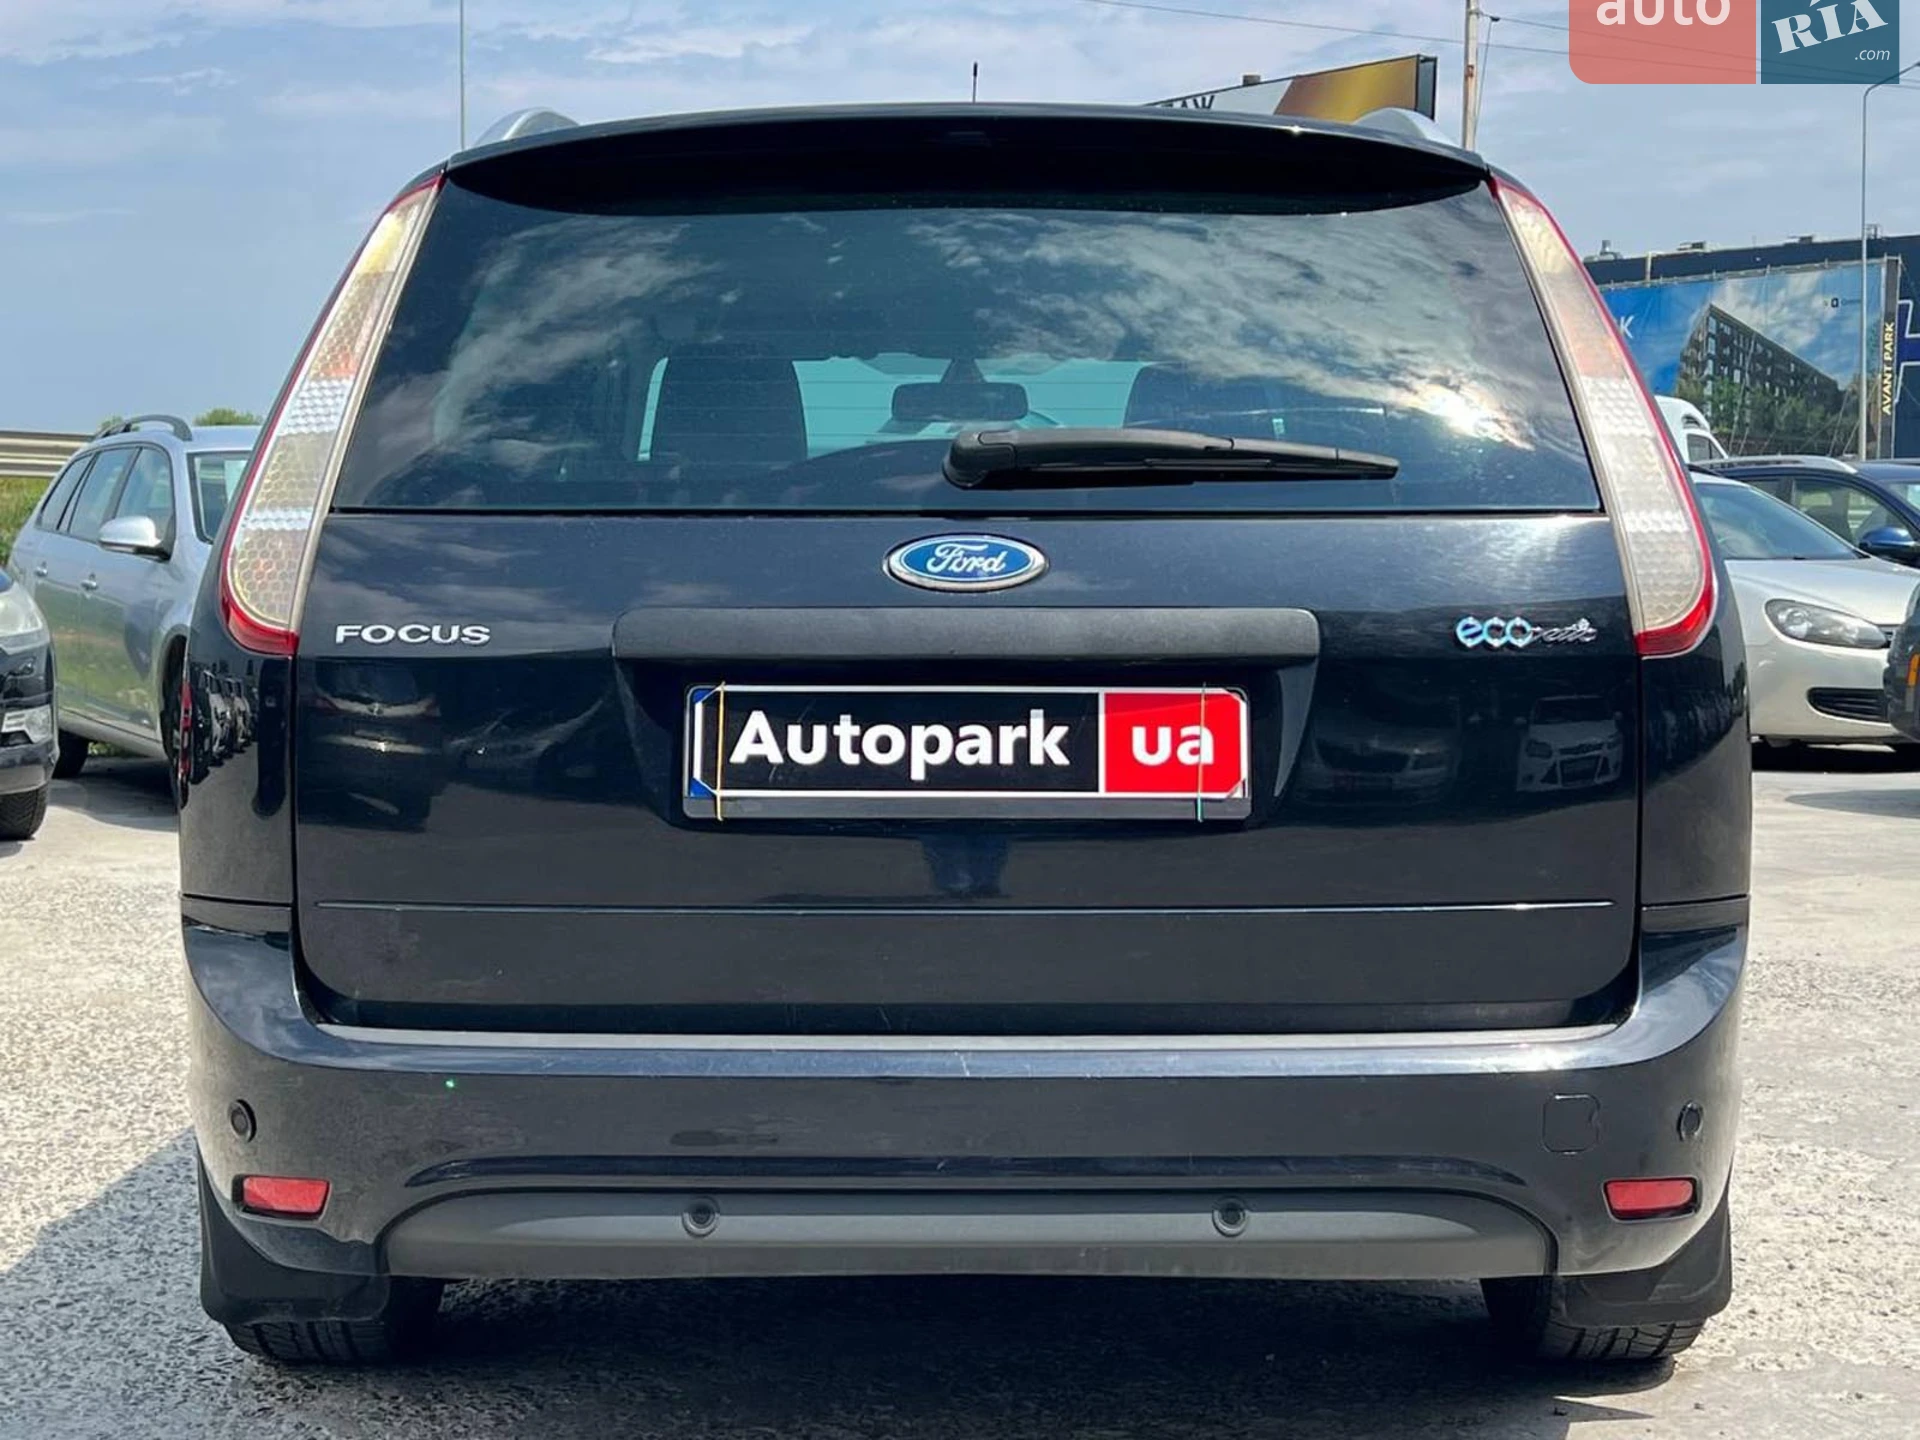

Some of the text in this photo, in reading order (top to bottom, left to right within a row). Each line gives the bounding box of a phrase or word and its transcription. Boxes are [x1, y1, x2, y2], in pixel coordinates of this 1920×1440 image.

[1880, 322, 1894, 416] AVANT PARK
[926, 543, 1008, 573] Ford
[336, 624, 491, 645] FOCUS
[729, 709, 1214, 781] Autopark ua
